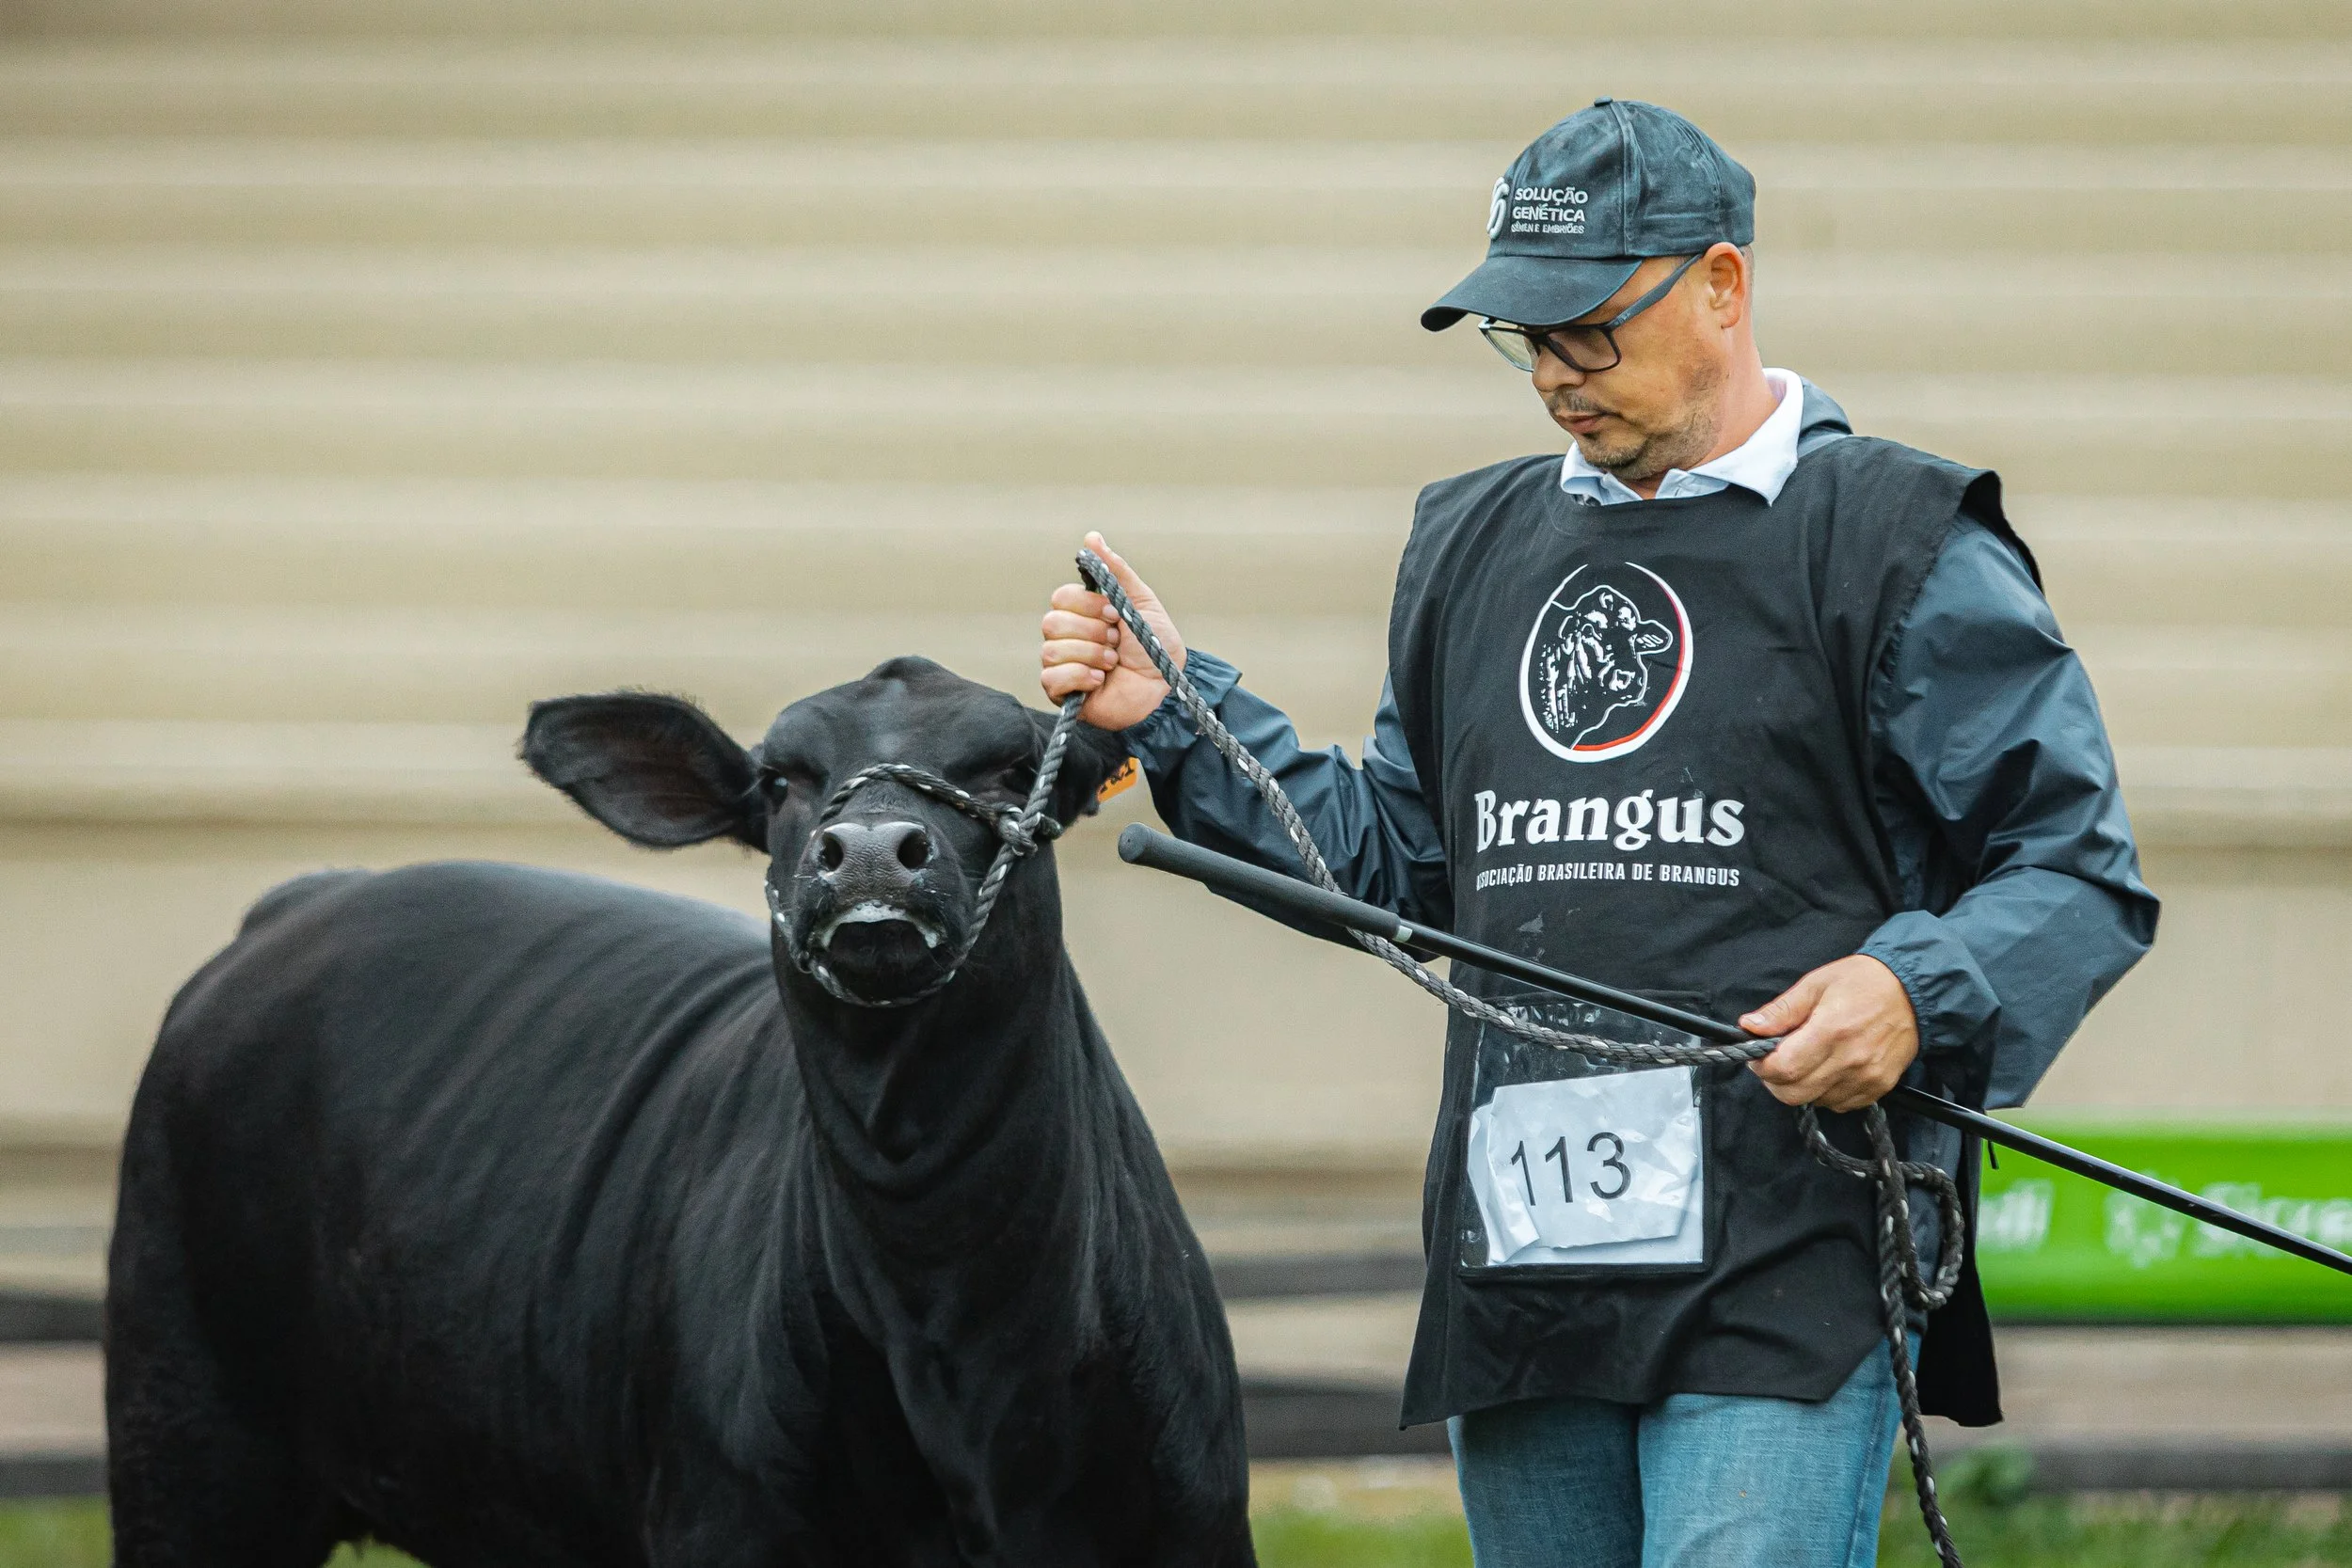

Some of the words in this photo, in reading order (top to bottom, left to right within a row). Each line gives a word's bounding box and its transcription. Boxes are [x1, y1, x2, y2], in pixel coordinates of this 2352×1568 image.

[1515, 186, 1589, 206] SOLUÇÃO
[1513, 203, 1585, 222] GENÉTICA
[1474, 788, 1745, 853] Brangus
[1537, 863, 1626, 881] BRASILEIRA
[1632, 863, 1652, 880] DE
[1660, 864, 1740, 887] BRANGUS
[1511, 1132, 1631, 1206] 113
